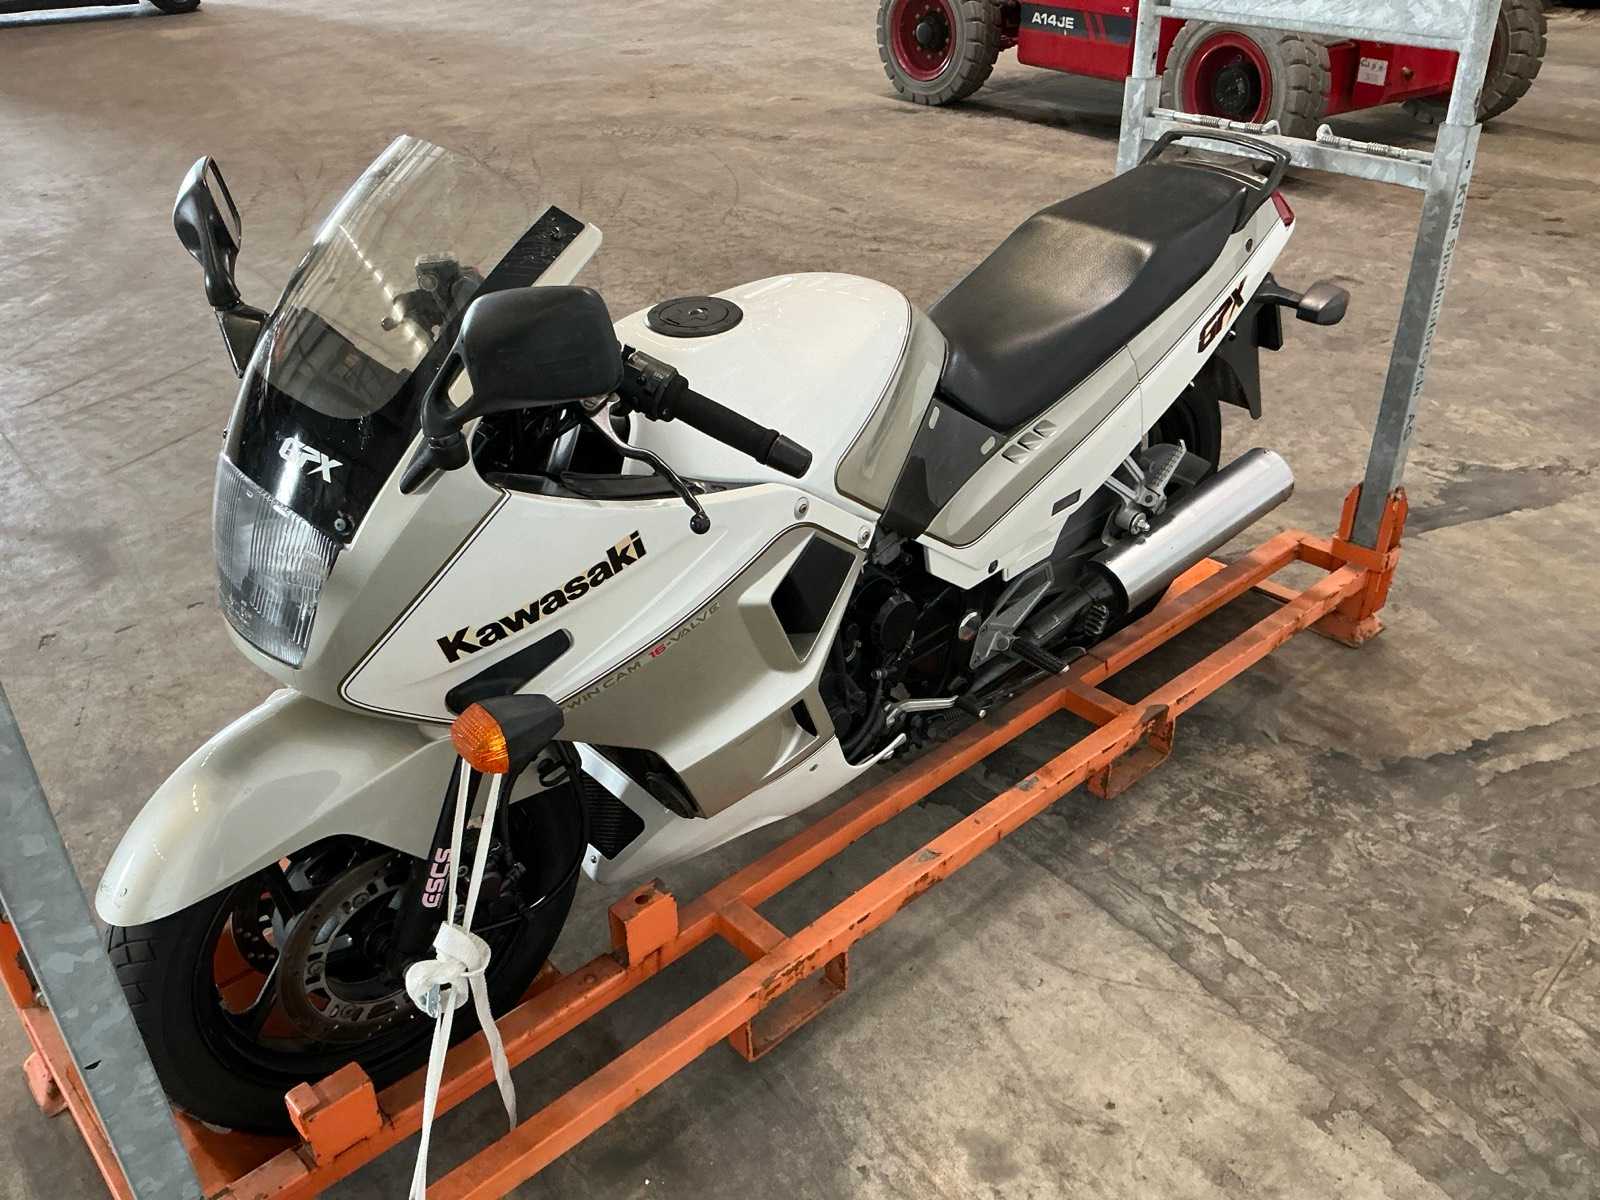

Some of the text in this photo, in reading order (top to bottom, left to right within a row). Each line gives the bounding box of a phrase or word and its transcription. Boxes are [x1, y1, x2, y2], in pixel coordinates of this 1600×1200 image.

[1031, 12, 1075, 30] A14JE
[1449, 183, 1468, 230] KTM
[437, 530, 647, 663] Kawasaki
[602, 661, 642, 689] CAM
[649, 602, 720, 658] 16-VALVE
